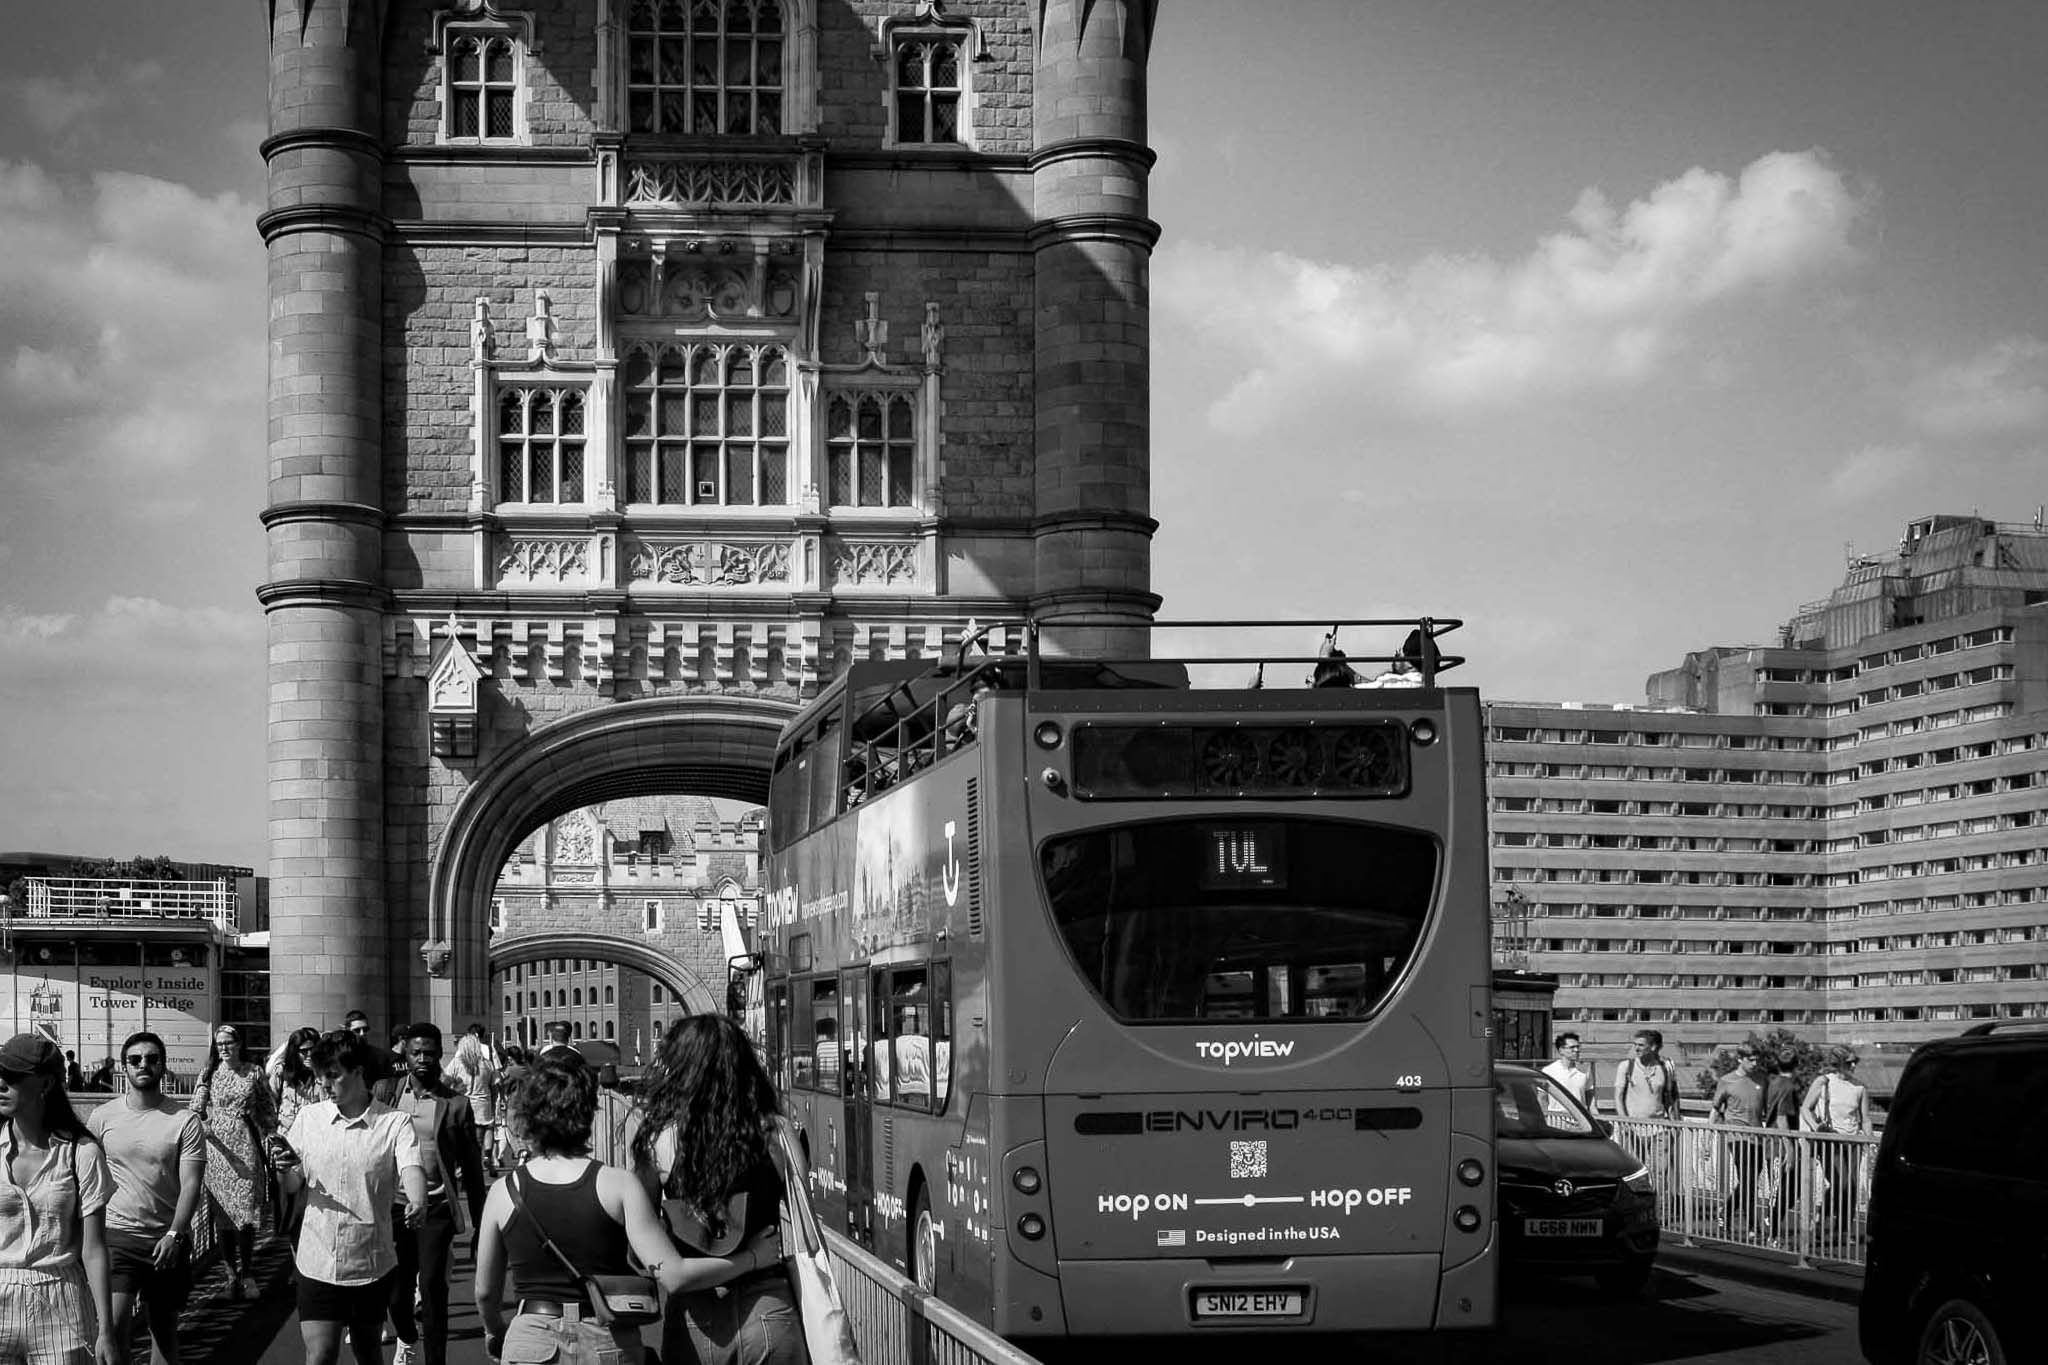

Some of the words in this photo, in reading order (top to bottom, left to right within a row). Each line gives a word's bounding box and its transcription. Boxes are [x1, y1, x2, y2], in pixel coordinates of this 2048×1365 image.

[89, 976, 153, 990] Explore
[157, 976, 205, 990] Inside
[89, 996, 138, 1009] Tower
[144, 997, 195, 1012] Bridge
[1396, 1075, 1422, 1087] 403
[1145, 1110, 1299, 1132] ENVIRO
[1302, 1107, 1353, 1122] 400
[1154, 1193, 1188, 1211] ON
[1366, 1187, 1412, 1206] OFF
[1195, 1227, 1266, 1245] Designed
[1309, 1227, 1341, 1240] USA
[1207, 1294, 1249, 1312] SN12
[1253, 1294, 1289, 1312] EHV
